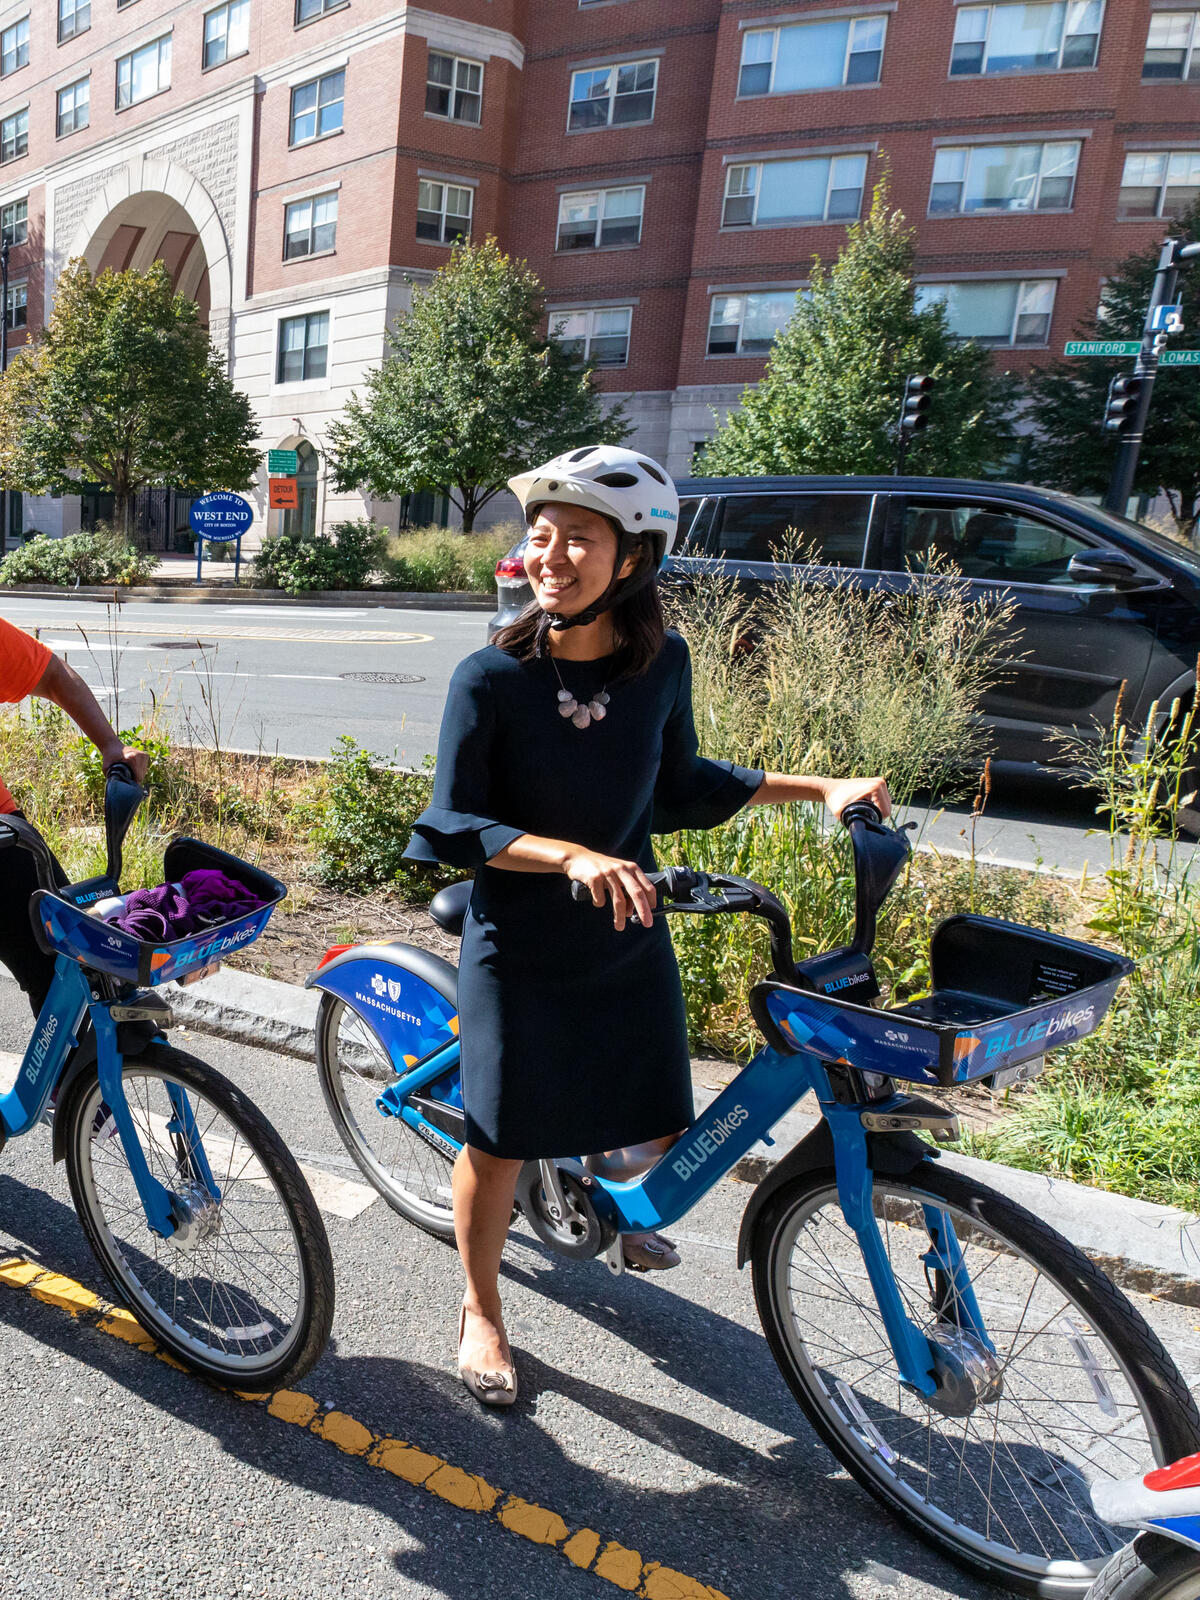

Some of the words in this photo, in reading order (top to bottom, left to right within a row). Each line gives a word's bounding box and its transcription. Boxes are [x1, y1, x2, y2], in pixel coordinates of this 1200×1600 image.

[1069, 343, 1126, 354] STANIFORD
[273, 485, 293, 493] DETOUR
[199, 494, 233, 505] WELCOME
[235, 497, 244, 506] TO
[193, 511, 224, 521] WEST
[225, 511, 249, 521] END
[75, 889, 114, 905] BLUEbikes
[174, 925, 257, 969] BLUEbikes
[824, 973, 870, 994] BLUEbikes
[355, 992, 422, 1027] MASSACHUSETTS
[985, 1005, 1095, 1059] BLUEbikes
[25, 1014, 58, 1085] BLUEbikes
[874, 1039, 928, 1054] MASSACHUSETTS
[671, 1104, 749, 1182] BLUEbikes
